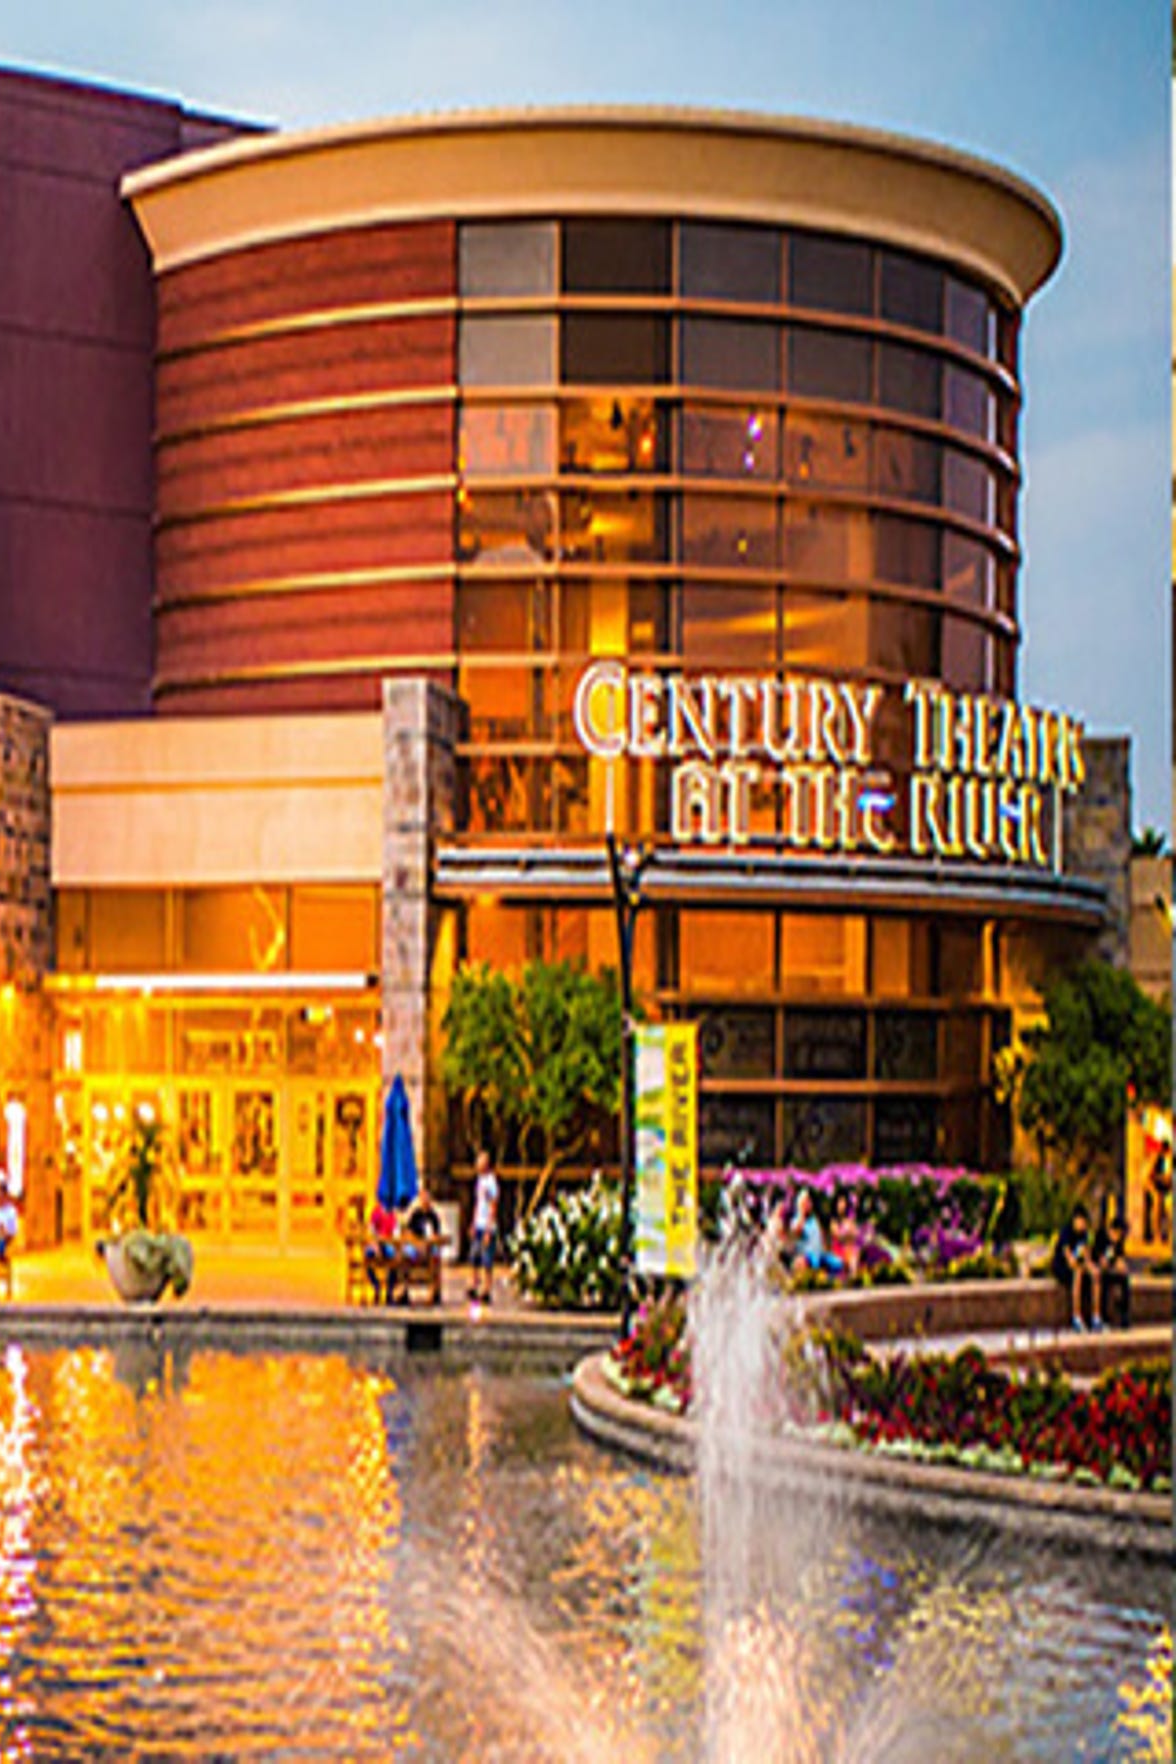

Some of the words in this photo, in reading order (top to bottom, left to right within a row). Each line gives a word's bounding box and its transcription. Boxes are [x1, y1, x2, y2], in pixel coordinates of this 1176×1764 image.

[575, 660, 883, 764] CENTURY
[670, 760, 760, 845] AT
[782, 762, 898, 853] THE
[909, 771, 1047, 867] RIVER
